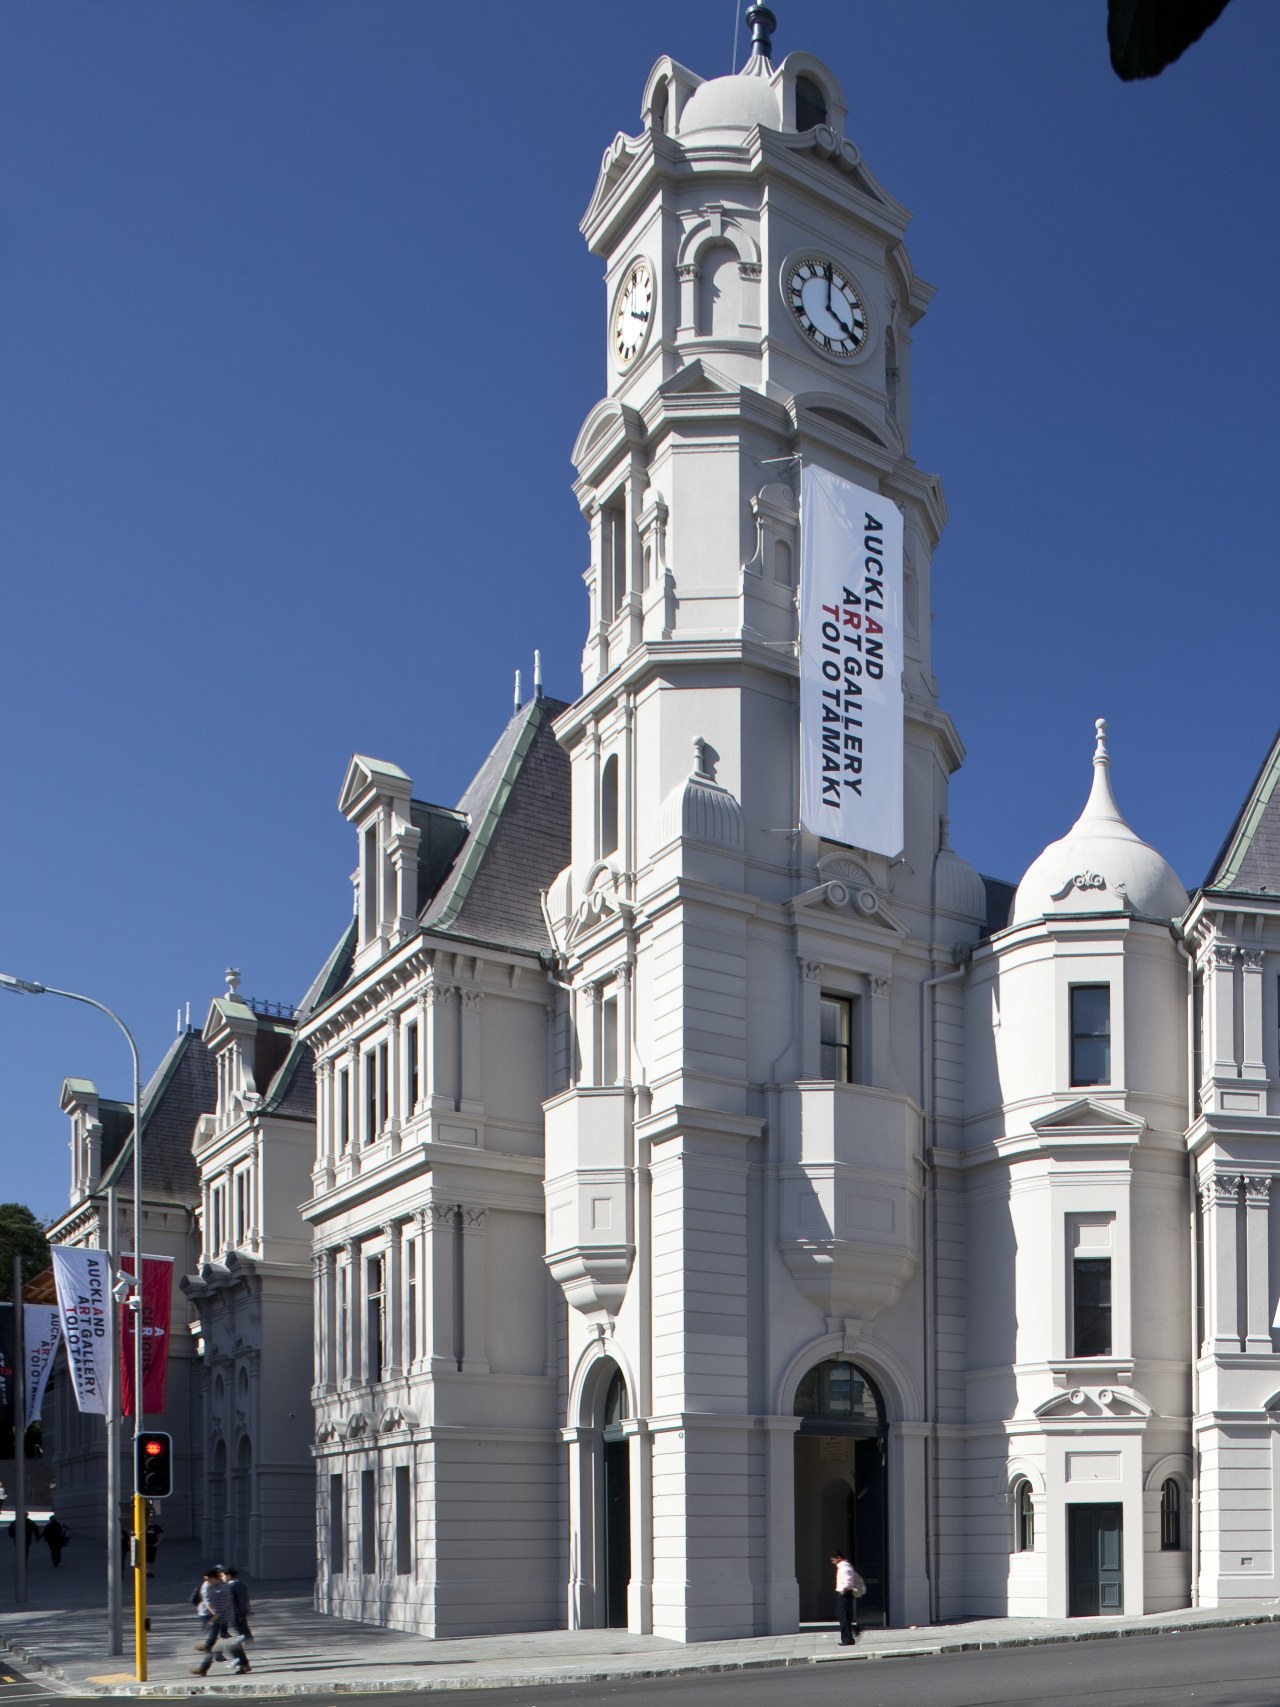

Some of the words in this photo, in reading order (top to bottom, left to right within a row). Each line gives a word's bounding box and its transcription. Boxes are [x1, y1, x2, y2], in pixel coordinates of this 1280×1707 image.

[863, 511, 884, 681] AUCKLAND
[821, 603, 841, 655] TOI
[842, 586, 862, 649] ART
[822, 660, 842, 682] O
[842, 656, 863, 797] GALLERY
[77, 1295, 92, 1326] ART
[86, 1258, 105, 1338] AUCKLAND
[65, 1305, 79, 1331] TOI
[154, 1326, 165, 1337] A
[68, 1334, 81, 1345] O
[31, 1347, 41, 1369] TOI
[31, 1369, 41, 1378] O
[80, 1328, 97, 1397] GALLERY
